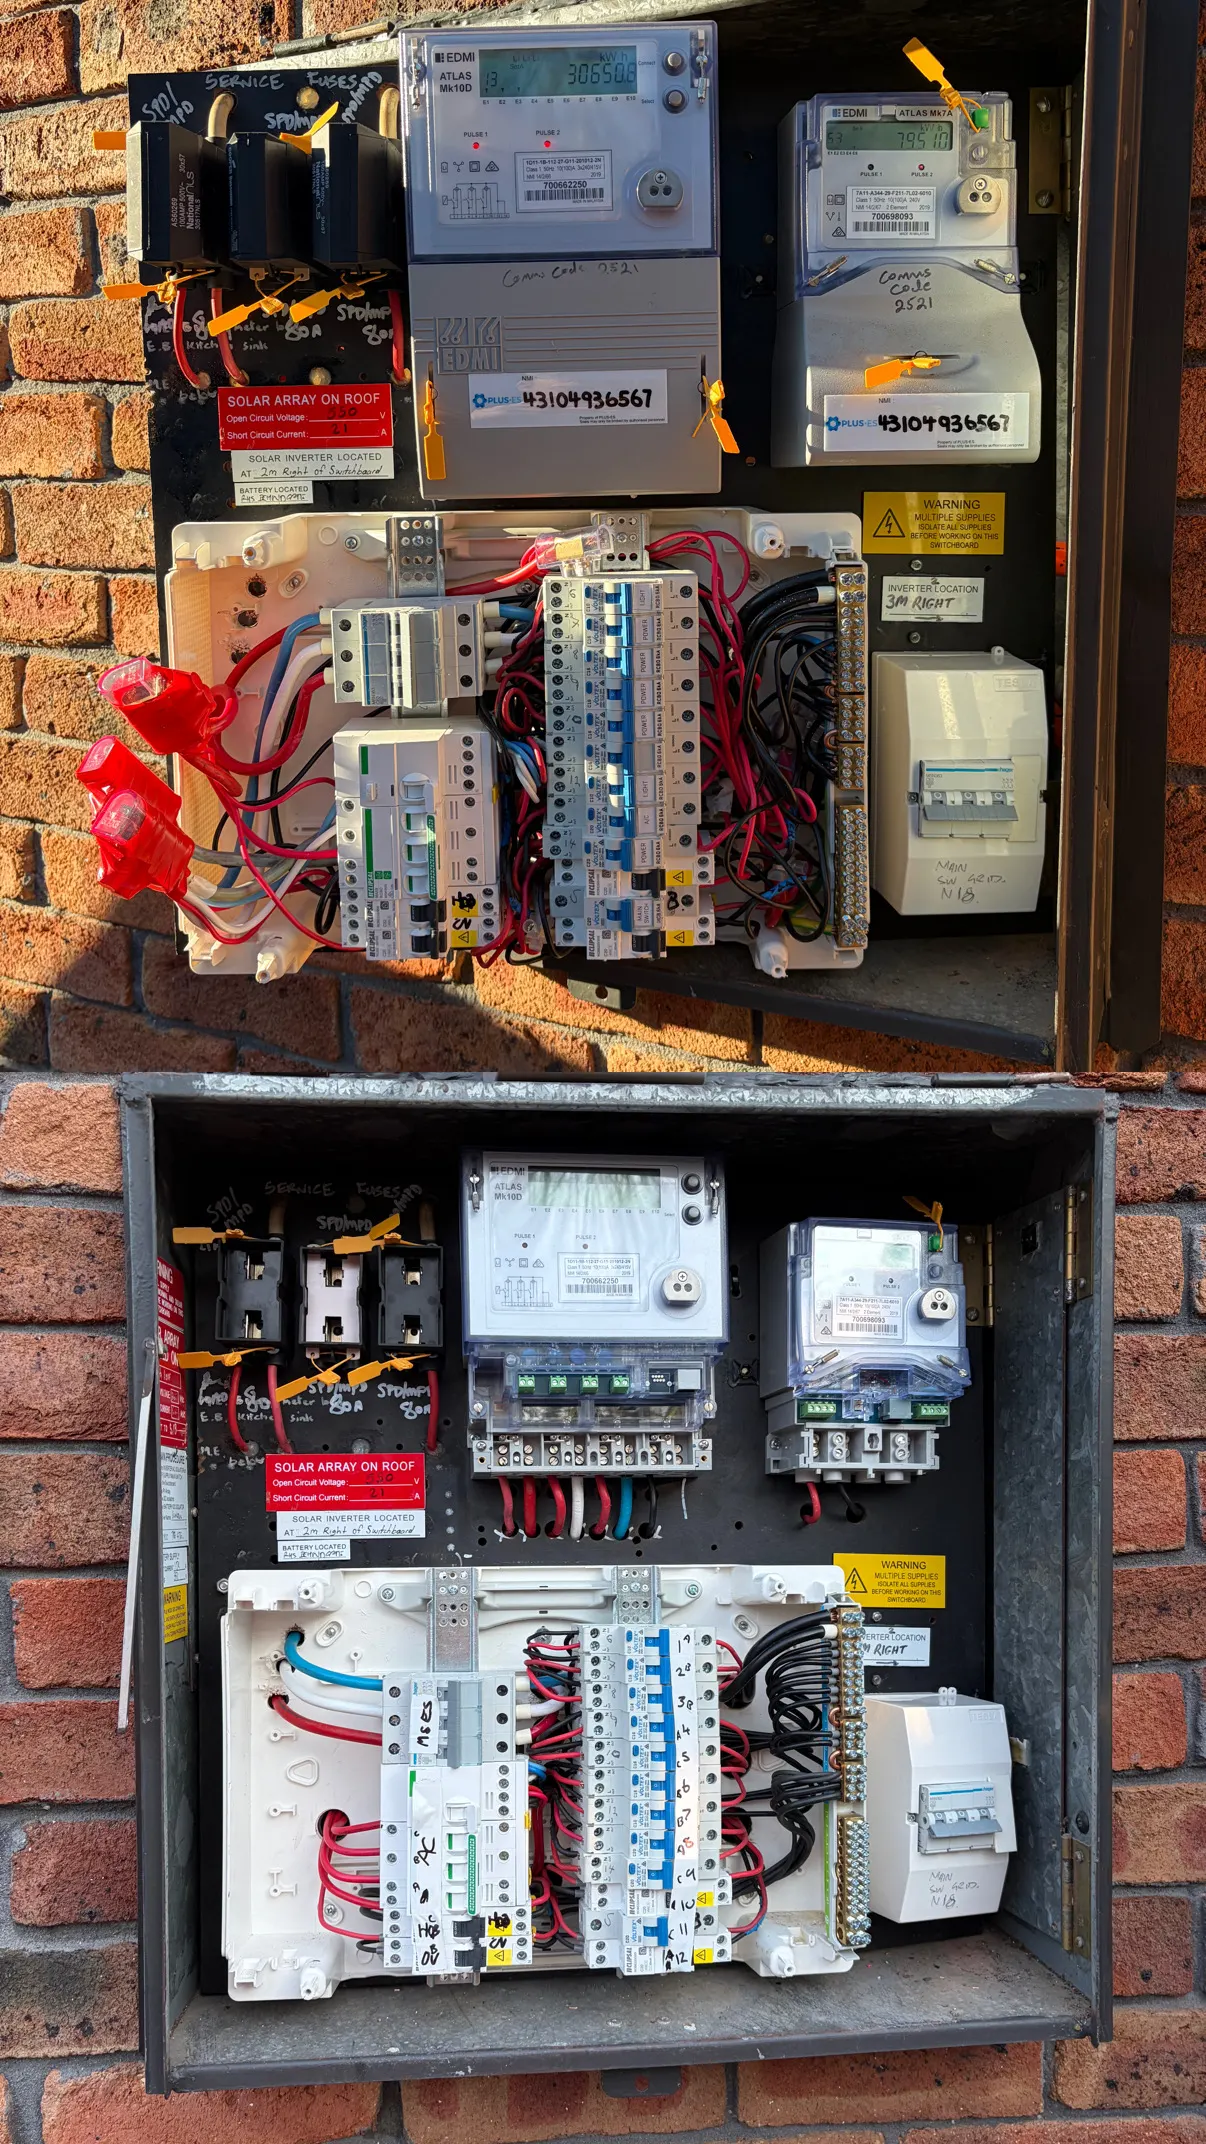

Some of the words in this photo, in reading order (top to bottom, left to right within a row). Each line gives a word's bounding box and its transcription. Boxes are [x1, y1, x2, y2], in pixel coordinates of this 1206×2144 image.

[447, 52, 475, 62] EDMI
[205, 73, 284, 90] SERVICE
[307, 72, 358, 89] FUSES
[439, 72, 472, 81] ATLAS
[439, 83, 472, 93] Mk10D
[842, 108, 868, 118] EDMI
[899, 109, 928, 117] ATLAS
[930, 109, 953, 117] Mk7A
[543, 181, 587, 189] 700662250
[186, 194, 195, 230] National
[895, 297, 933, 314] 2521
[446, 349, 498, 371] EDMI
[228, 396, 270, 407] SOLAR
[275, 395, 316, 406] ARRAY
[321, 394, 340, 405] ON
[344, 393, 381, 404] ROOF
[523, 389, 653, 409] 43104936567
[226, 415, 247, 424] Open
[249, 414, 274, 422] Circuit
[878, 414, 1010, 433] 43104936567
[227, 431, 248, 440] Short
[250, 430, 274, 439] Circuit
[332, 424, 348, 434] 21
[249, 455, 281, 463] SOLAR
[285, 454, 333, 463] INVERTER
[337, 453, 382, 461] LOCATED
[240, 470, 251, 478] AT
[282, 467, 309, 478] Right
[314, 465, 326, 475] of
[328, 463, 383, 475] Switchboard
[924, 499, 981, 510] WARNING
[956, 514, 996, 522] SUPPLIES
[888, 584, 932, 592] INVERTER
[934, 585, 979, 593] LOCATION
[886, 595, 908, 609] 3M
[912, 597, 955, 610] RIGHT
[935, 860, 968, 872] MAIN
[937, 876, 957, 885] SW
[501, 1167, 525, 1176] EDMI
[265, 1182, 335, 1196] SERVICE
[494, 1183, 522, 1191] ATLAS
[494, 1192, 522, 1201] Mk10D
[275, 1462, 315, 1473] SOLAR
[318, 1461, 357, 1472] ARRAY
[361, 1461, 378, 1471] ON
[382, 1461, 415, 1471] ROOF
[273, 1479, 292, 1488] Open
[294, 1478, 318, 1487] Circuit
[273, 1494, 293, 1502] Short
[294, 1494, 318, 1502] Circuit
[326, 1515, 371, 1523] INVERTER
[374, 1514, 415, 1522] LOCATED
[323, 1526, 348, 1537] Right
[352, 1525, 364, 1534] of
[366, 1524, 416, 1535] Switchboard
[881, 1561, 926, 1570] WARNING
[677, 1640, 682, 1653] 1
[874, 1643, 908, 1656] RIGHT
[676, 1668, 685, 1677] 2
[678, 1696, 686, 1708] 3
[682, 1724, 691, 1736] 4
[682, 1751, 690, 1762] 5
[682, 1779, 691, 1793] 6
[682, 1808, 691, 1821] 7
[683, 1837, 694, 1849] 8
[686, 1868, 696, 1881] 9
[930, 1872, 953, 1882] MAIN
[930, 1885, 945, 1893] SW
[681, 1899, 695, 1912] 10
[679, 1922, 688, 1936] 11
[676, 1951, 688, 1965] 12
